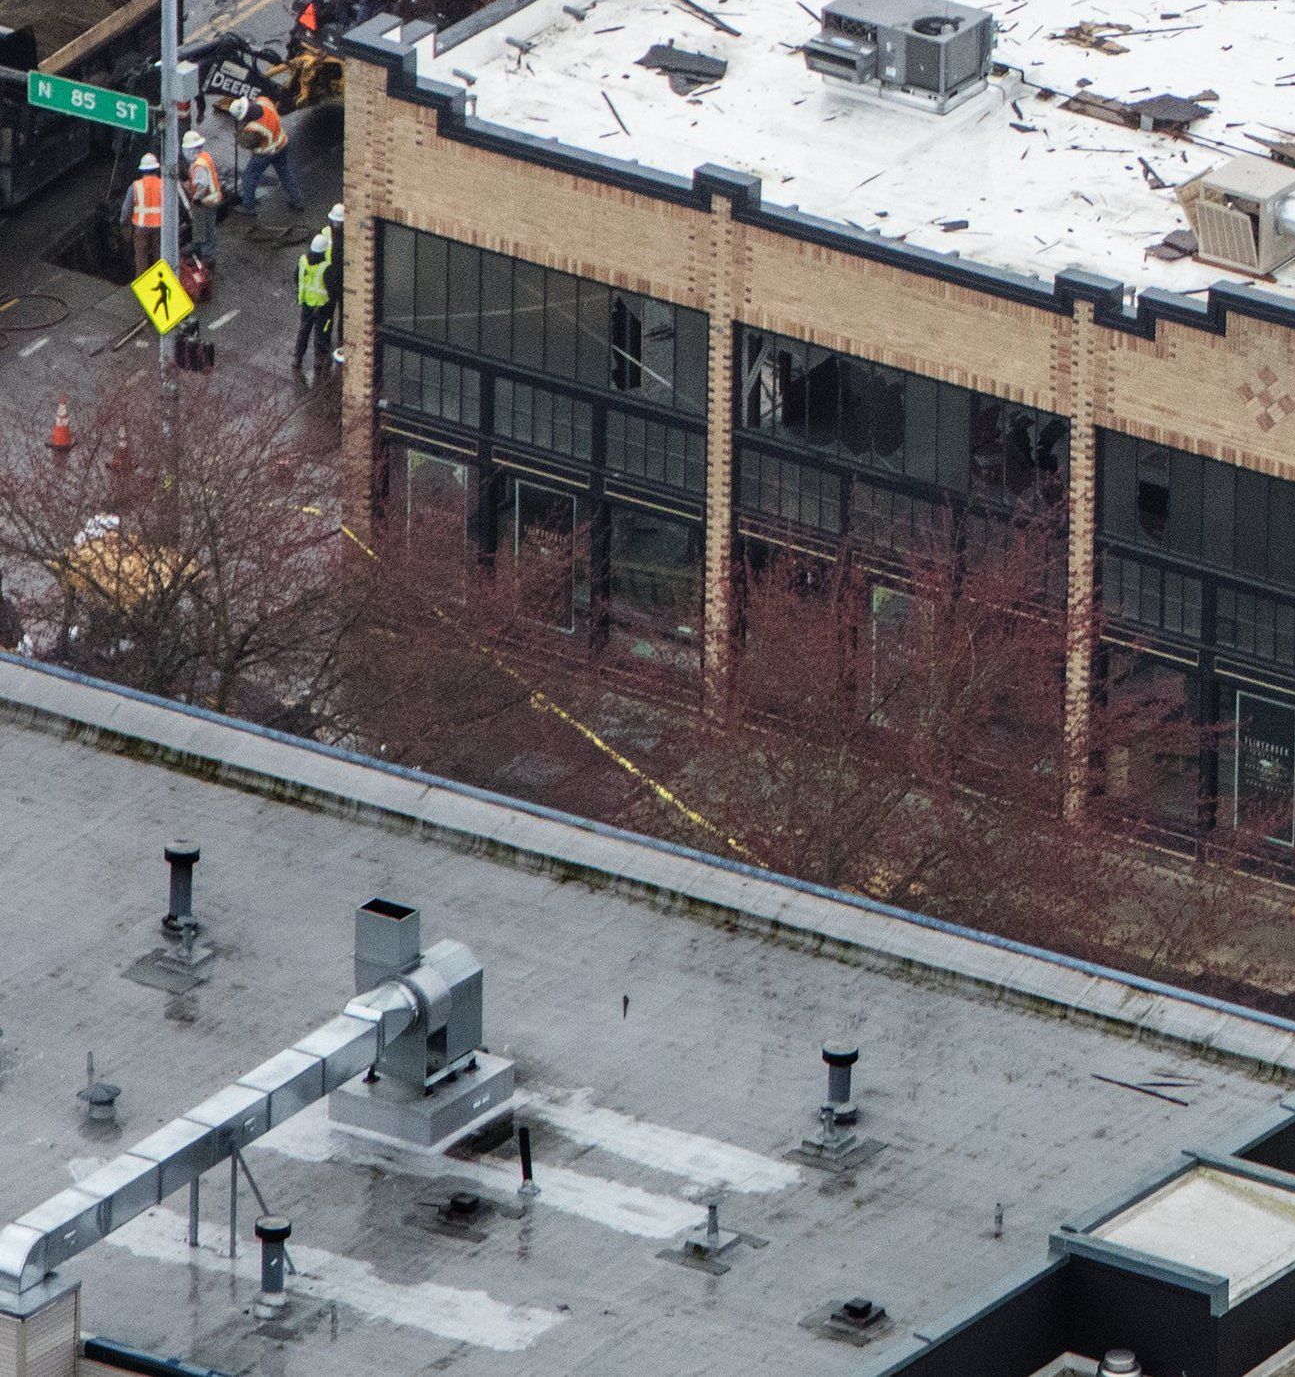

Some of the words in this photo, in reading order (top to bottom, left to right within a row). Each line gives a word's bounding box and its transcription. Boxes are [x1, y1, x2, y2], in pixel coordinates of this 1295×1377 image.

[38, 80, 51, 99] N
[71, 89, 96, 110] 85
[115, 100, 138, 120] ST
[211, 71, 261, 101] DEERE
